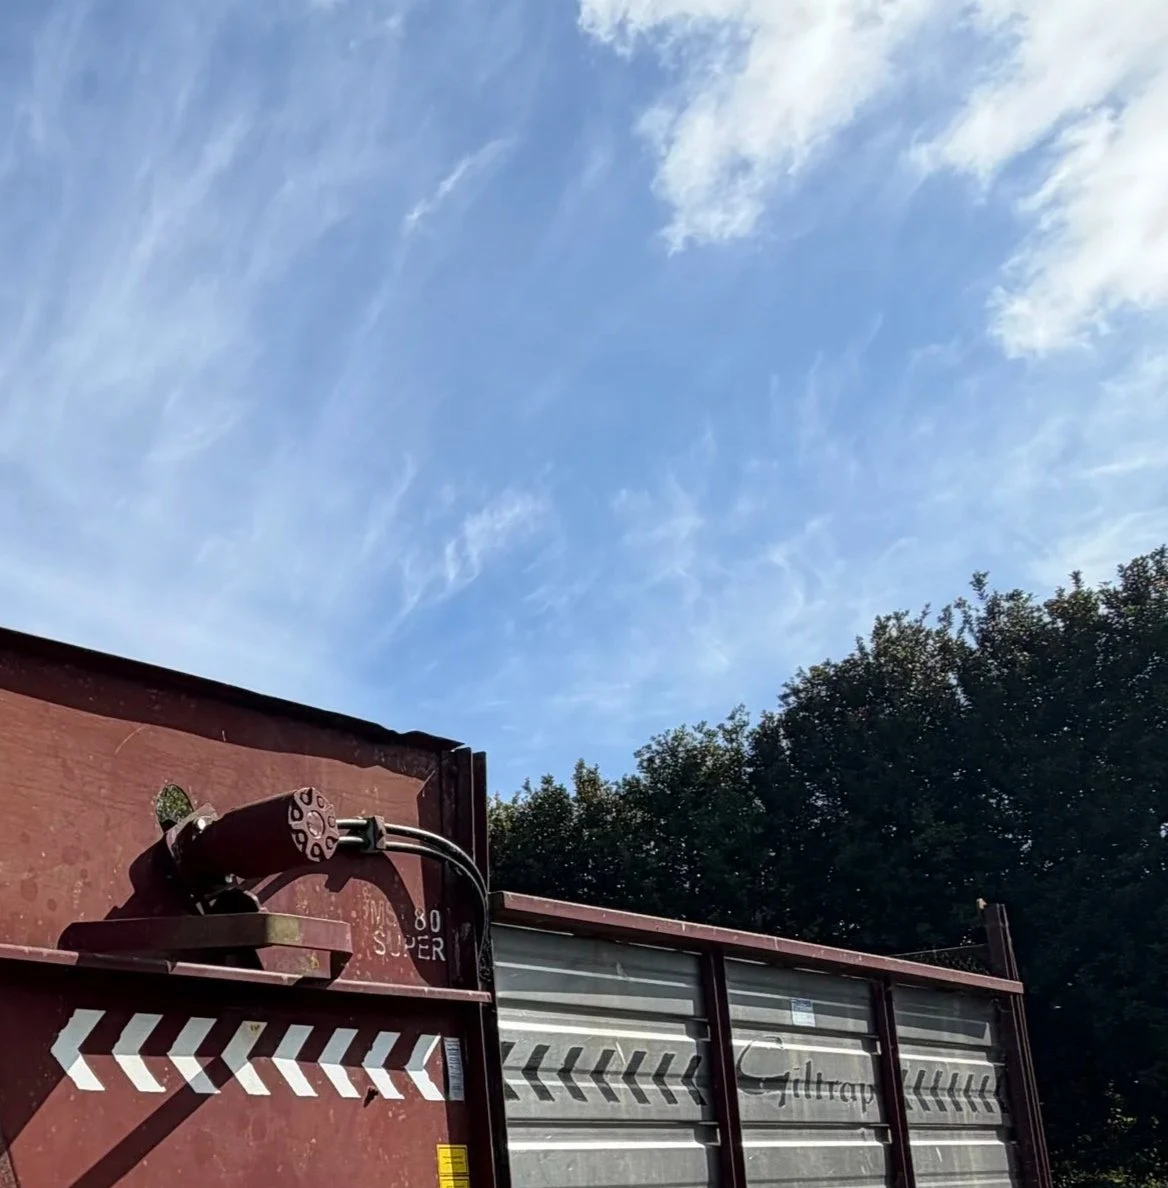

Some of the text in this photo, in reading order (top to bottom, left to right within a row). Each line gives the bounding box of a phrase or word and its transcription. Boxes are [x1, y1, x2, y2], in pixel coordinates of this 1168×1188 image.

[414, 908, 441, 932] 80
[373, 930, 446, 961] SUPER
[736, 1036, 875, 1113] Giltrap
